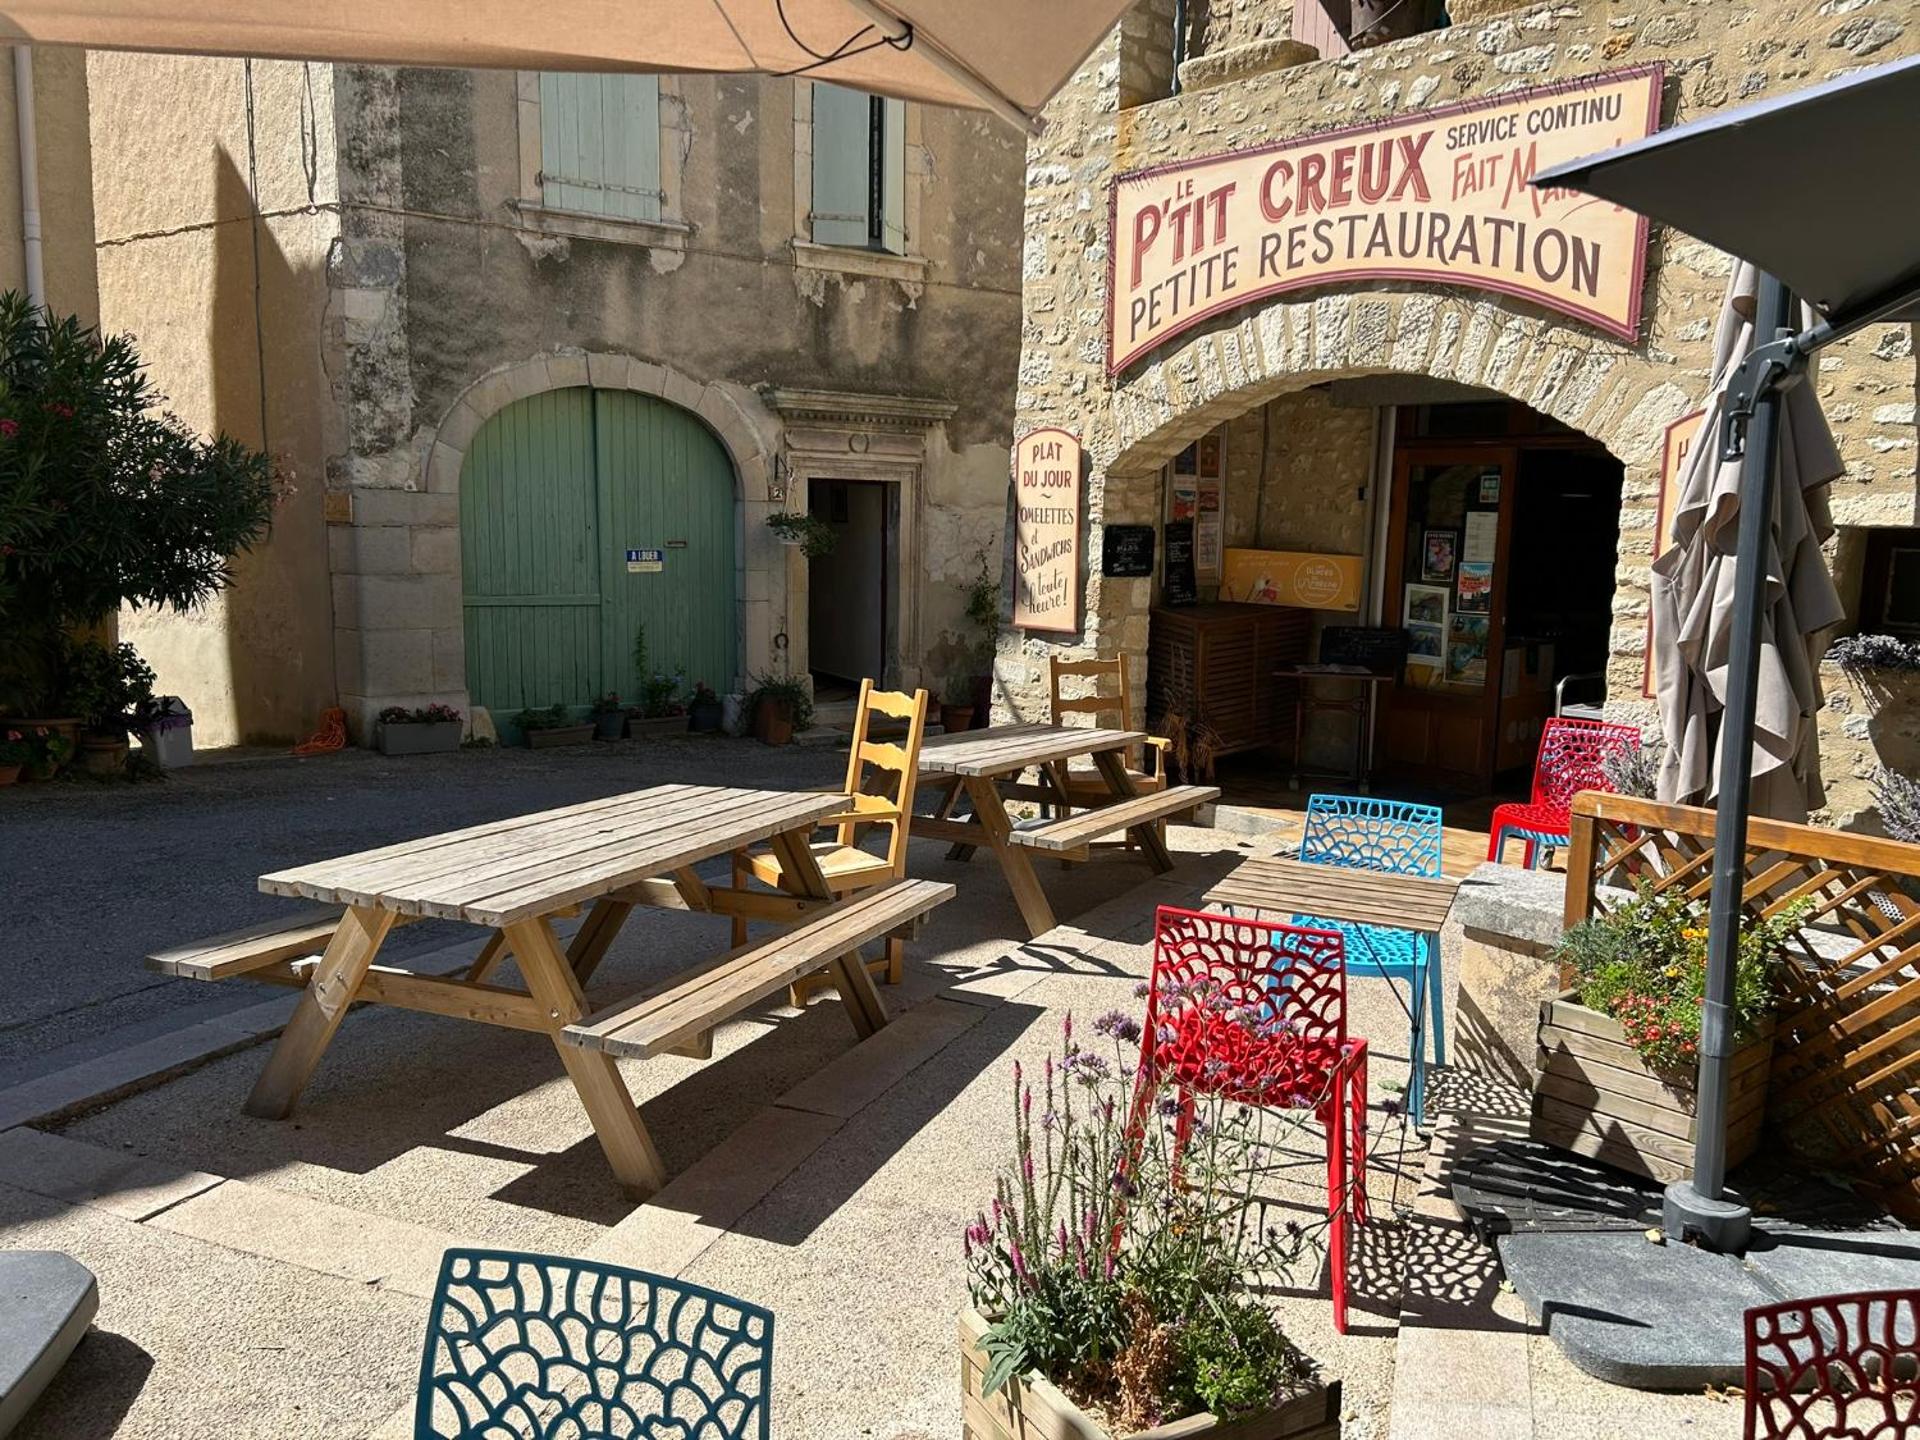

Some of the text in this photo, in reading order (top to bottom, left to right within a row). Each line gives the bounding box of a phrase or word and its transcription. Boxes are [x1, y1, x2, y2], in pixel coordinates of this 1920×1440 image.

[1446, 93, 1622, 150] SERVICE CONTINU
[1177, 178, 1194, 200] LE
[1452, 152, 1504, 201] FAIT
[1130, 181, 1237, 292] P'TIT
[1259, 130, 1435, 223] CREUX
[1130, 211, 1601, 343] PETITE RESTAURATION
[1032, 441, 1063, 464] PLAT
[1024, 470, 1072, 489] DU JOUR
[1020, 507, 1074, 525] OMELETTES
[1031, 528, 1038, 546] et
[1020, 538, 1072, 574] SANDWICHS
[1021, 577, 1068, 614] heure!
[1037, 568, 1063, 596] toute
